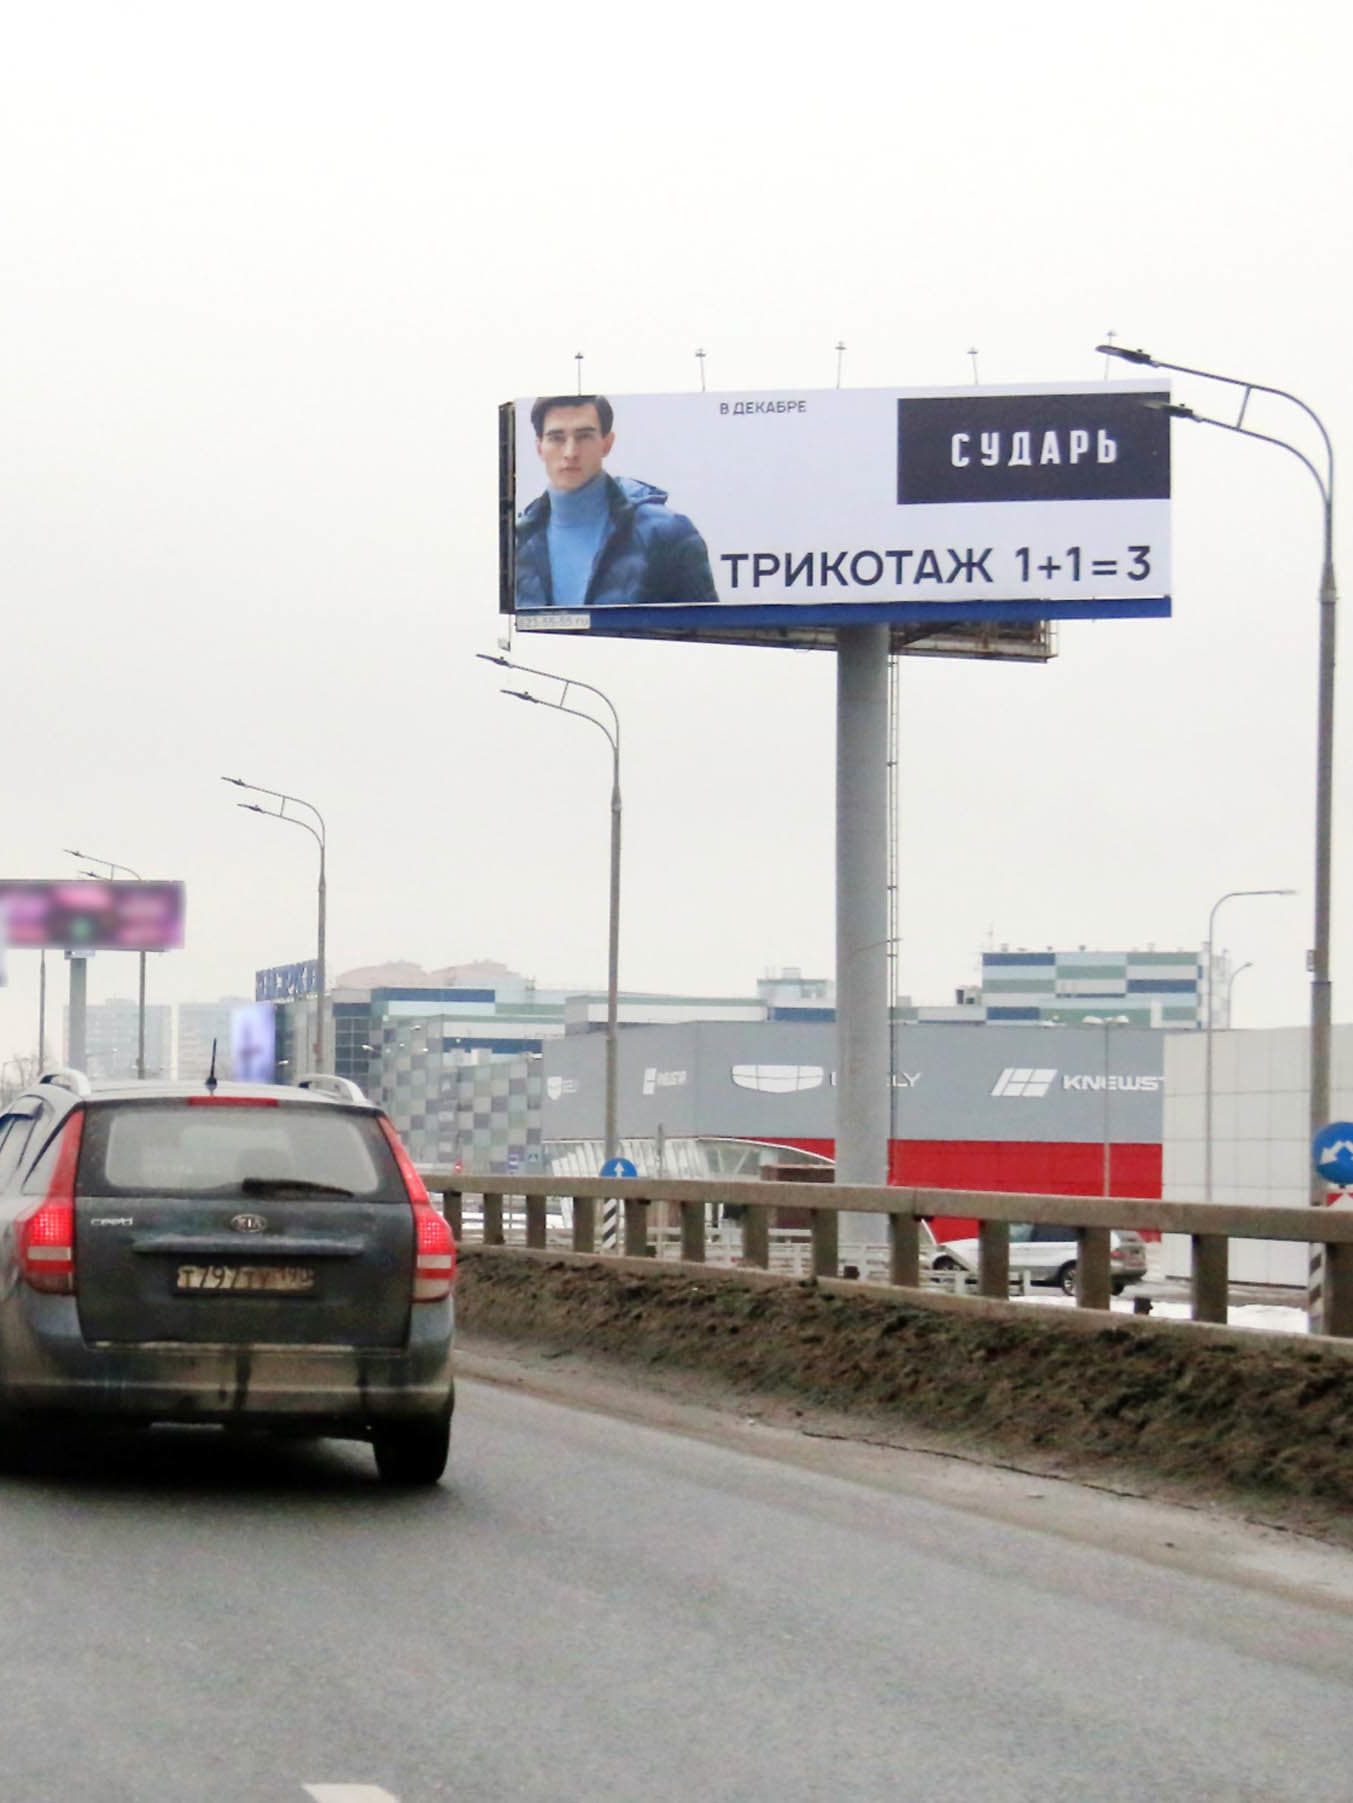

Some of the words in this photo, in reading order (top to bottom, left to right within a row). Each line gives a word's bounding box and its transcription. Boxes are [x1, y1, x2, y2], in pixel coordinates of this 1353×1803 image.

[719, 402, 730, 415] В
[732, 400, 808, 416] ДЕКАБРЕ
[950, 429, 1118, 468] СУДАРЬ
[720, 547, 993, 589] ТРИКОТАЖ
[1015, 544, 1152, 583] 1+1=3
